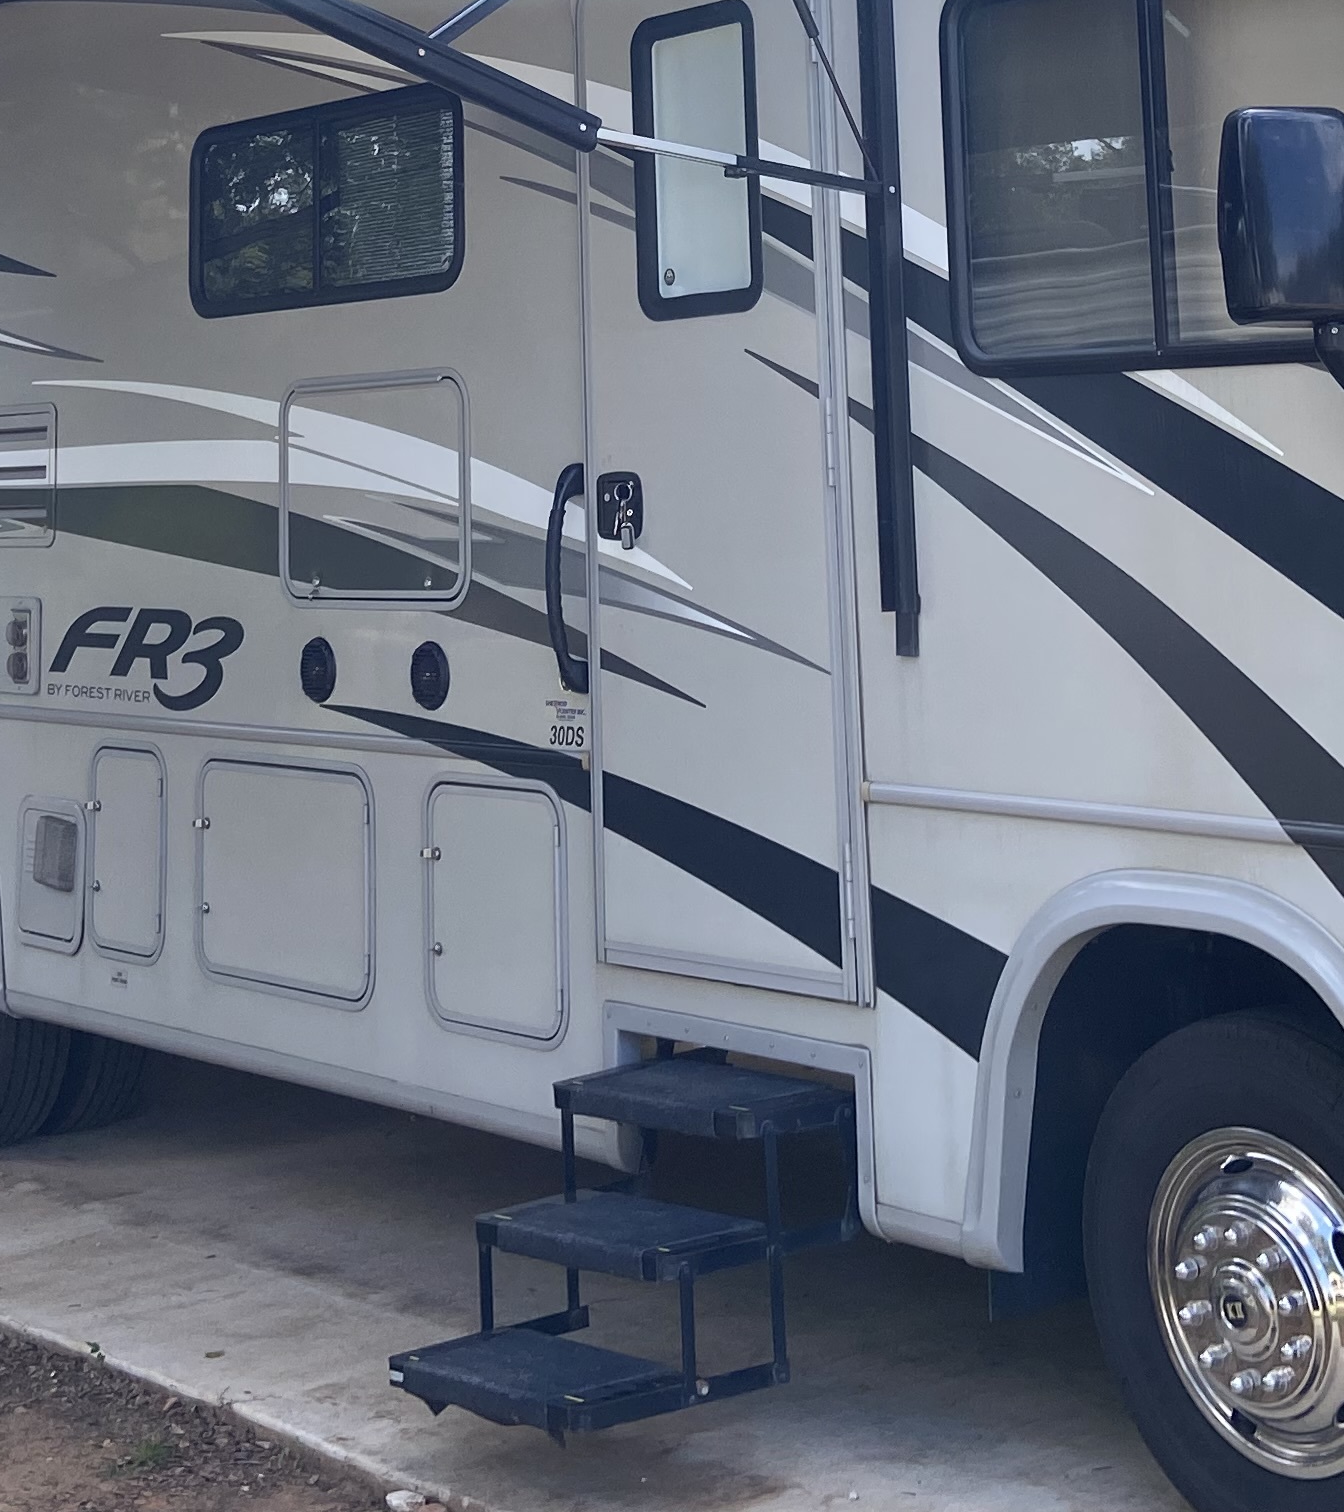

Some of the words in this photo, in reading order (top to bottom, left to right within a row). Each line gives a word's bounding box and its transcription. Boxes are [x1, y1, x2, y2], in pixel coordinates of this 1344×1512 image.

[48, 606, 245, 712] FR3
[47, 683, 63, 696] BY
[65, 685, 111, 700] FOREST
[114, 688, 151, 703] RIVER
[549, 725, 585, 747] 30DS
